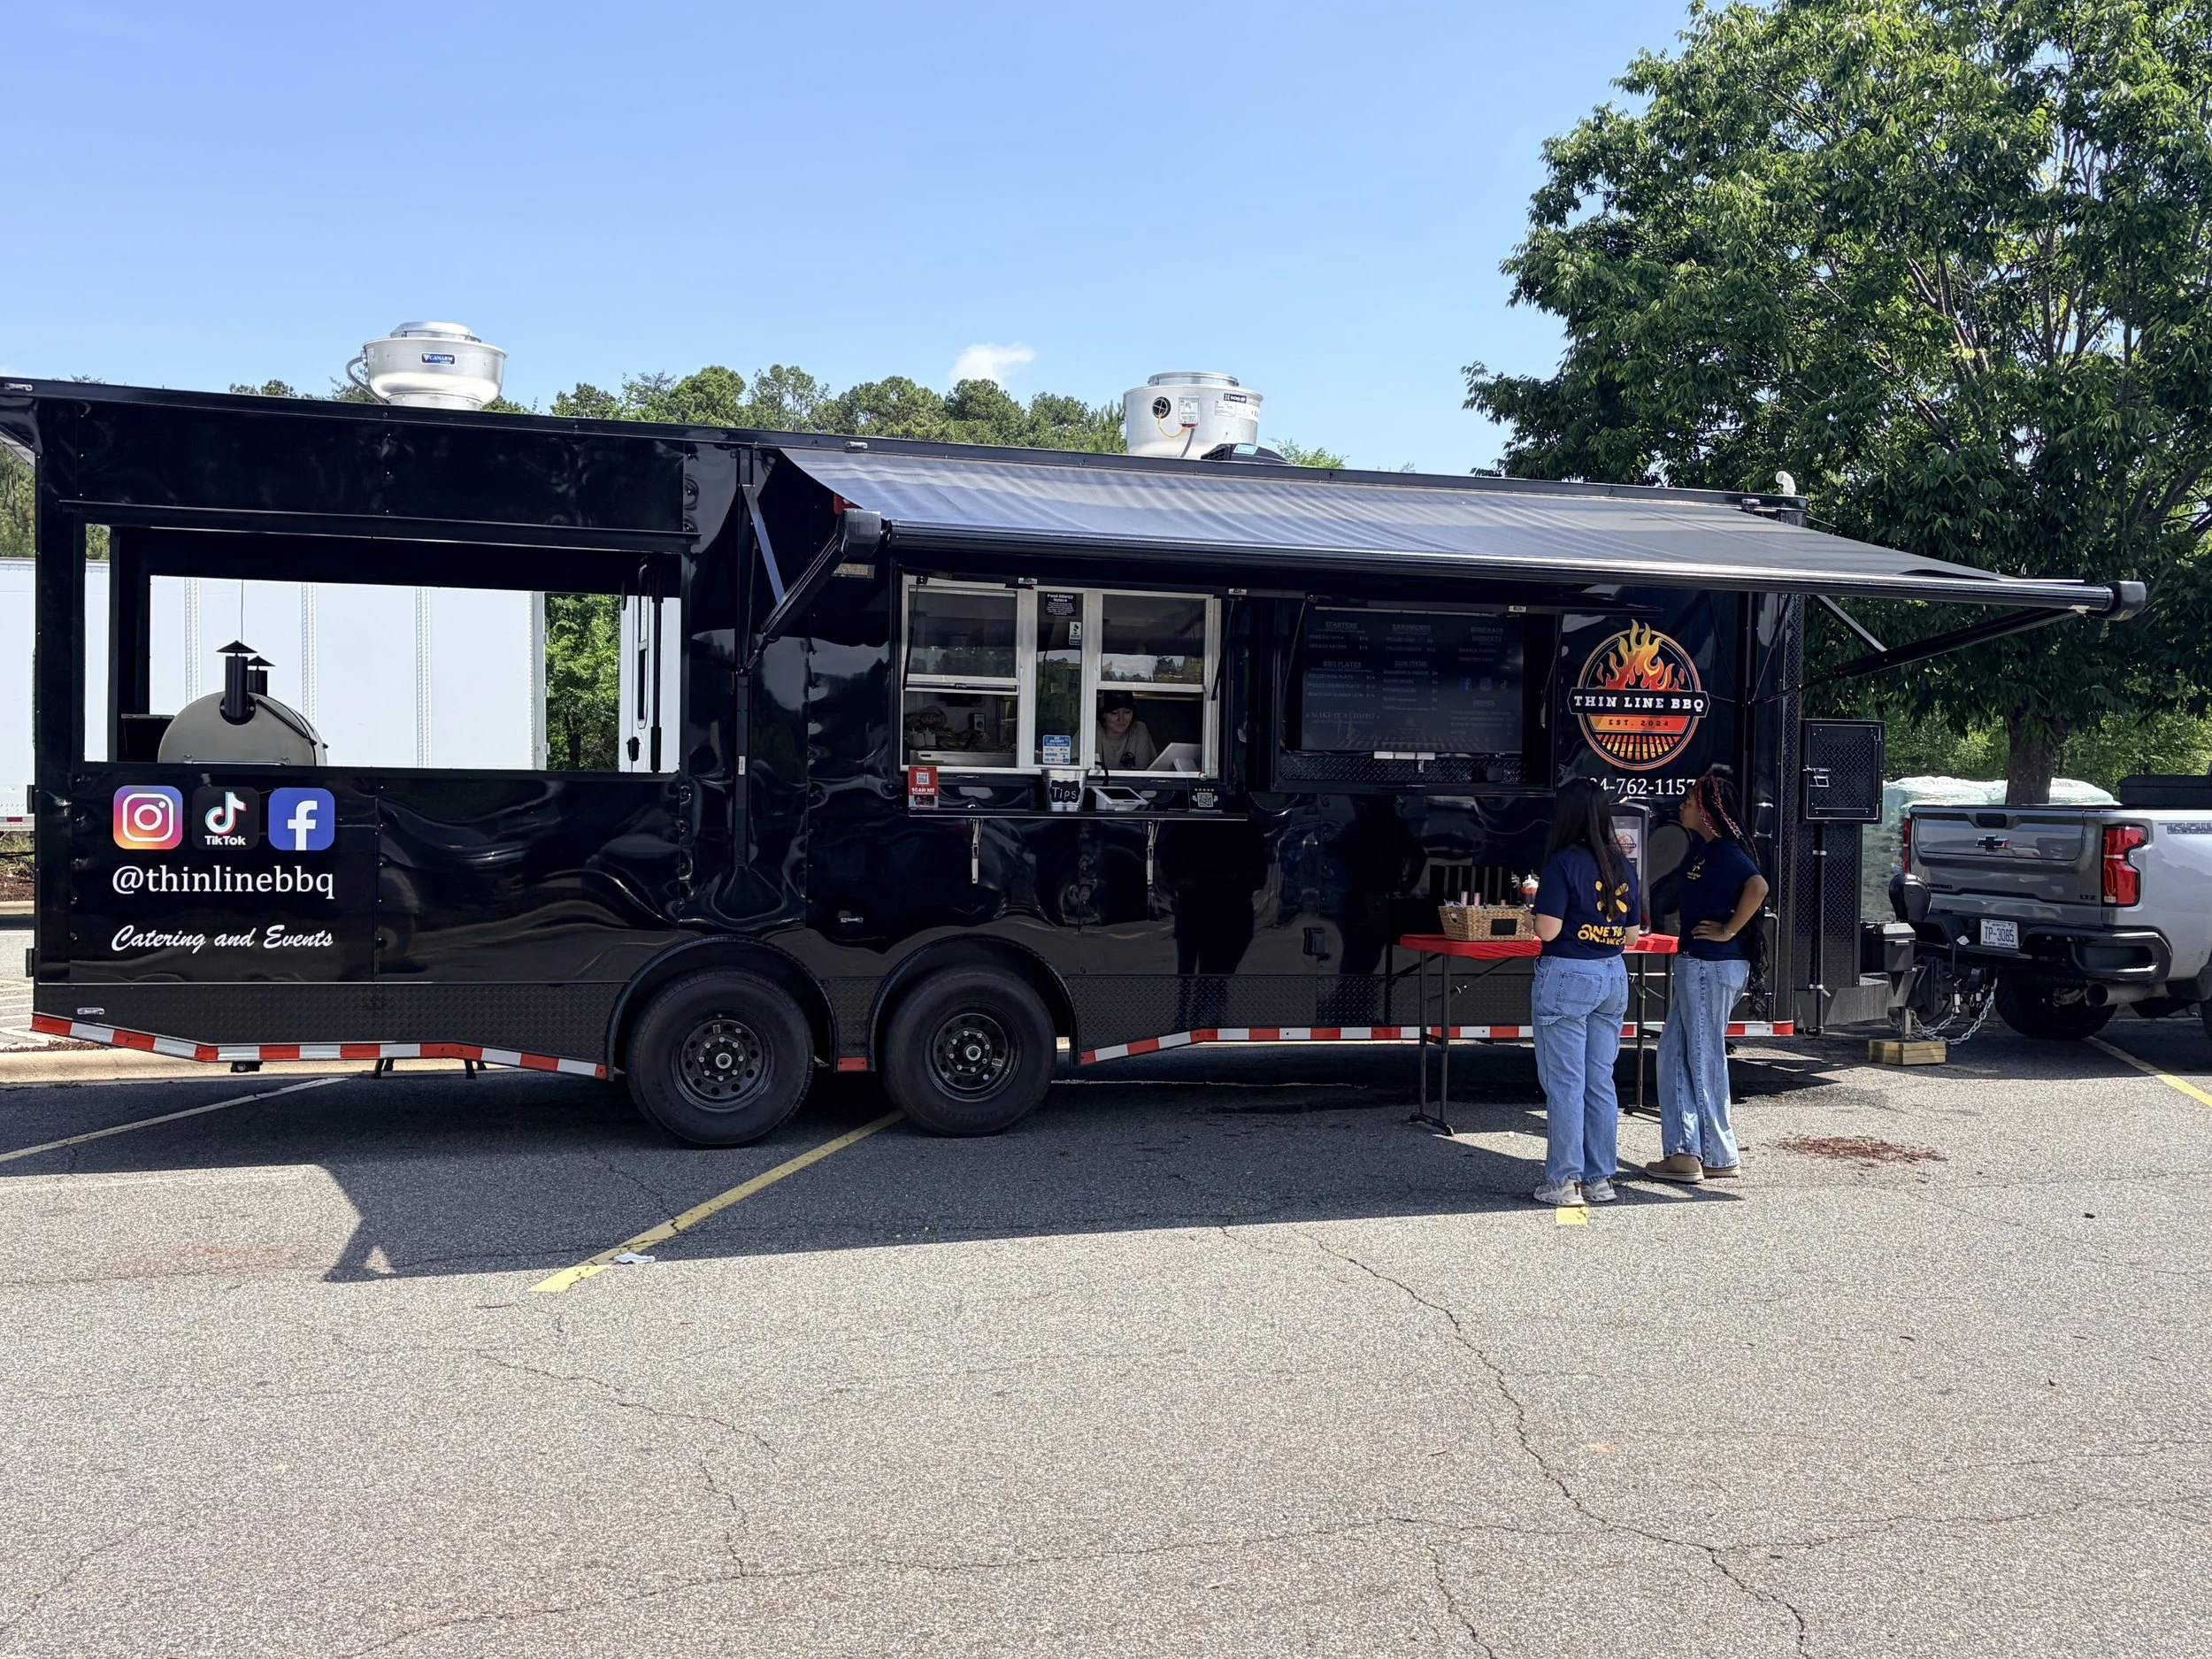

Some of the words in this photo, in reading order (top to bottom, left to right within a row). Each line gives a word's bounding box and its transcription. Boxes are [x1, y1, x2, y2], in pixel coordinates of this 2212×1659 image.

[1574, 695, 1617, 708] THIN
[1624, 696, 1664, 709] LINE
[1671, 698, 1704, 712] BBQ
[1051, 787, 1077, 801] Tips
[204, 835, 247, 846] TikTok
[112, 865, 335, 899] @thinlinebbq
[111, 925, 206, 954] Catering
[213, 928, 257, 947] and
[263, 925, 334, 948] Events
